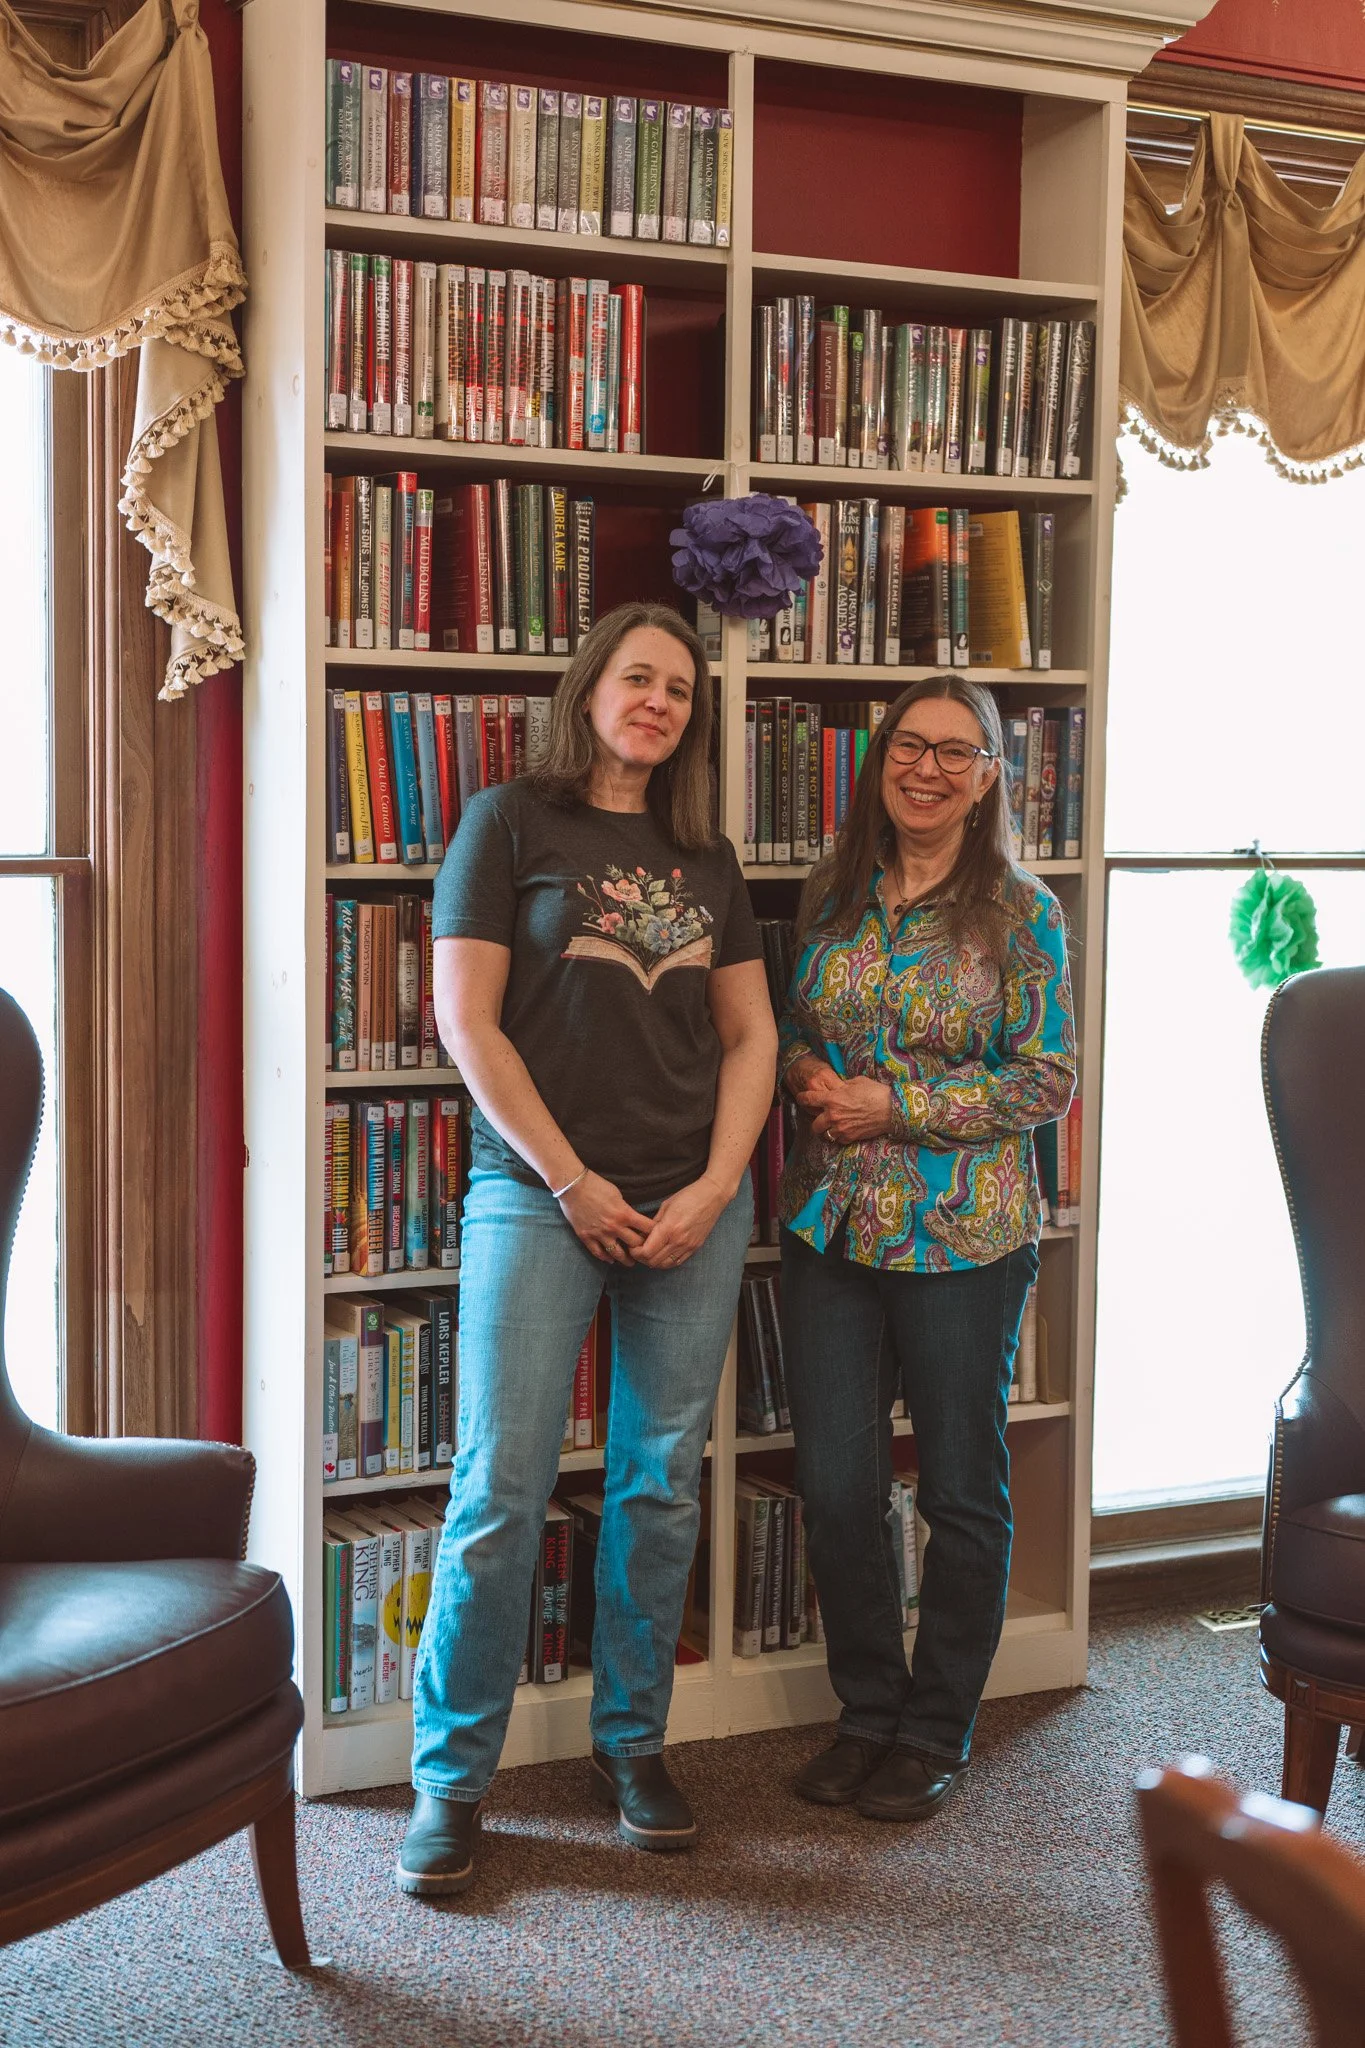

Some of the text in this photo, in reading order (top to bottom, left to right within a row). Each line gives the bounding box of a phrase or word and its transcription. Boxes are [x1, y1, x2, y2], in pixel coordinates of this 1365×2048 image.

[494, 168, 502, 198] CHAOS
[650, 141, 658, 195] GATHERING
[706, 148, 714, 186] MEMORY
[397, 282, 409, 302] IRIS
[377, 281, 389, 360] IRIS JOHANSEN
[397, 304, 409, 347] JOHANSEN
[1049, 362, 1060, 409] KOONTZ
[570, 426, 582, 442] STAR
[554, 493, 566, 538] ANDREA
[361, 529, 371, 576] SONS TIM
[555, 542, 566, 572] KANE
[578, 519, 590, 610] THE PRODIGAL
[870, 533, 879, 583] Penitence
[891, 563, 899, 576] WE
[892, 537, 901, 561] RIVER
[419, 535, 430, 612] MUDBOUND
[480, 552, 489, 593] HENNA
[891, 578, 899, 627] REMEMBER
[541, 717, 549, 743] JAN
[377, 720, 392, 838] KARON Out to Canaan
[402, 718, 411, 750] KARON
[409, 803, 418, 826] Song
[797, 751, 807, 837] THE OTHER MRS
[810, 741, 818, 839] SHE'S NOT SORRY
[340, 906, 353, 1002] ASK AGAIN, YES
[363, 920, 371, 985] TRAGEDY'S TWIN
[406, 949, 415, 1004] Bitter River
[425, 1000, 434, 1037] MURDER
[332, 1155, 350, 1207] KELLERMAN
[417, 1149, 427, 1199] KELLERMAN
[368, 1157, 385, 1254] KELLERMAN KILLER
[392, 1148, 401, 1248] KELLERMAN BREAKDOWN
[447, 1146, 458, 1248] KELLERMAN NIGHT MOVES
[439, 1311, 450, 1340] LARS
[439, 1342, 450, 1385] KEPLER
[580, 1347, 589, 1397] HAPPINESS
[328, 1384, 336, 1402] Other
[420, 1412, 428, 1444] KENEALLY
[353, 1545, 370, 1601] KING
[369, 1541, 378, 1600] STEPHEN
[383, 1548, 393, 1566] KING
[391, 1540, 401, 1573] STEPHEN
[412, 1545, 422, 1564] KING
[420, 1537, 430, 1570] STEPHEN
[544, 1536, 556, 1569] KING
[556, 1524, 569, 1579] STEPHEN
[542, 1585, 554, 1625] BEAUTIES
[555, 1583, 567, 1625] SLEEPING
[542, 1632, 553, 1665] KING
[555, 1627, 566, 1666] OWEN
